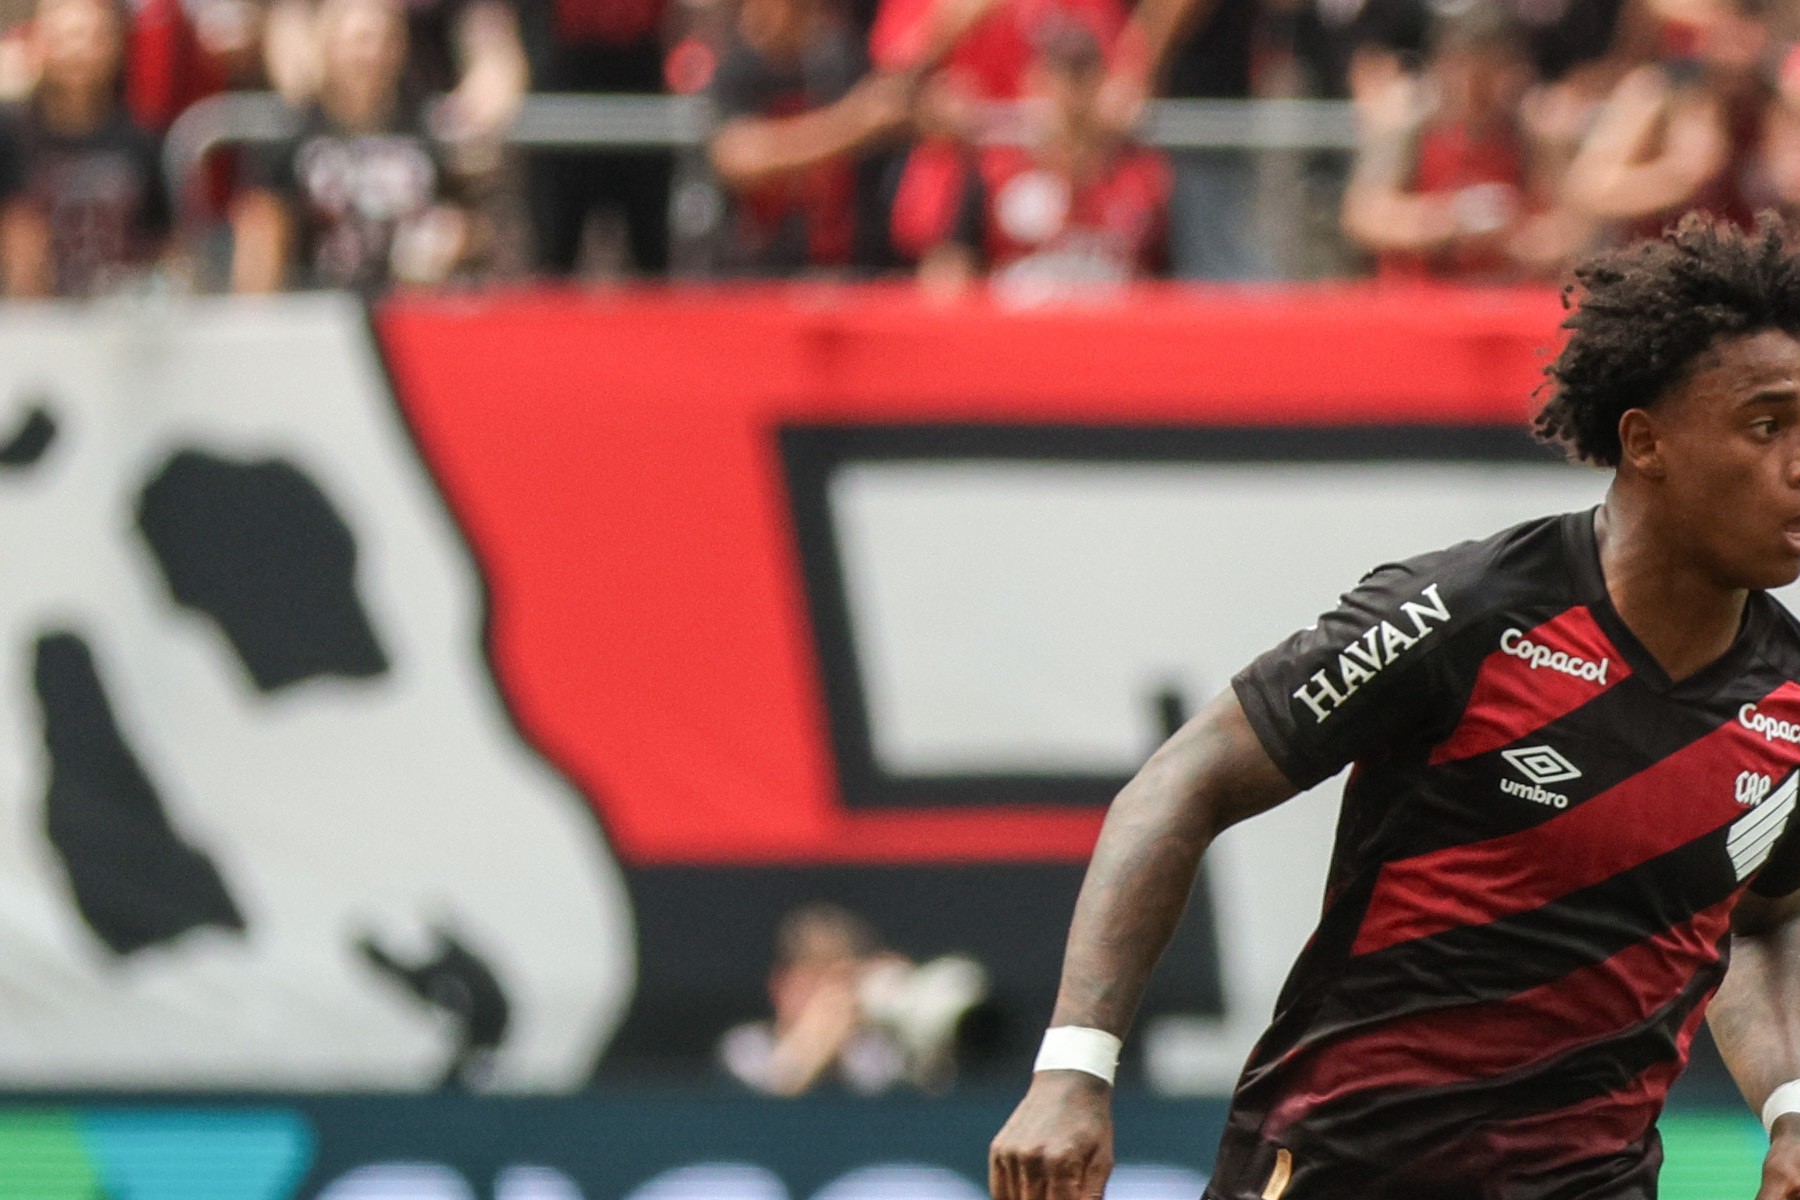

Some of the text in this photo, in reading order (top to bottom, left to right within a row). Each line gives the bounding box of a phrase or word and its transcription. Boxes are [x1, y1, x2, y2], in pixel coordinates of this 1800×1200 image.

[1293, 583, 1451, 724] HAVAN
[1499, 627, 1609, 686] Copacol
[1500, 778, 1568, 809] umbro
